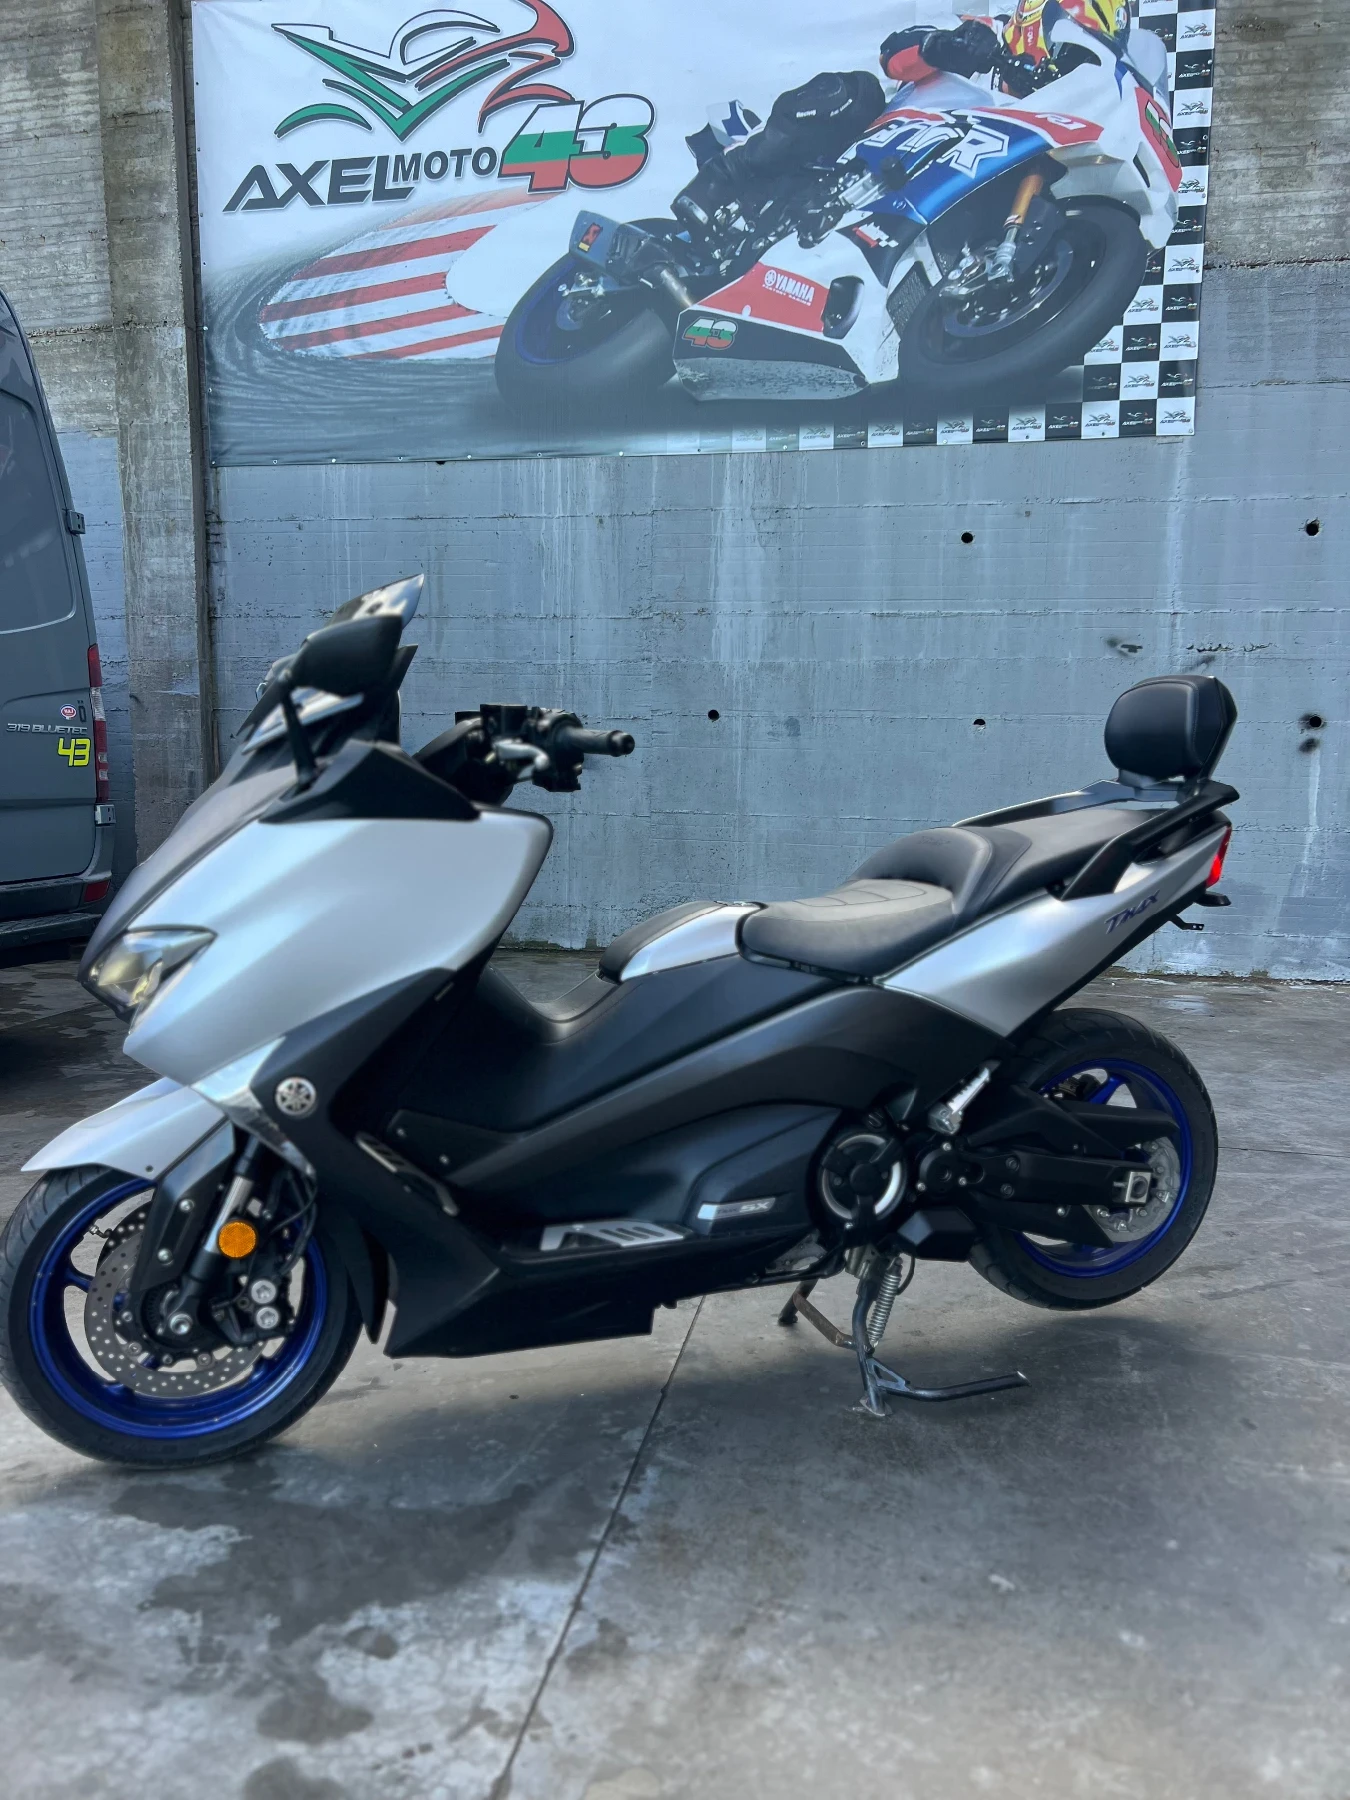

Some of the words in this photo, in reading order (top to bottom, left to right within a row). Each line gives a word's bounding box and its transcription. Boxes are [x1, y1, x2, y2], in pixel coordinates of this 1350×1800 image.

[497, 92, 656, 195] 43
[774, 273, 815, 302] YAMAHA
[682, 317, 738, 350] 43
[7, 723, 31, 733] 319
[31, 724, 88, 735] BLUETEC
[57, 737, 91, 767] 43
[739, 1201, 770, 1213] SX
